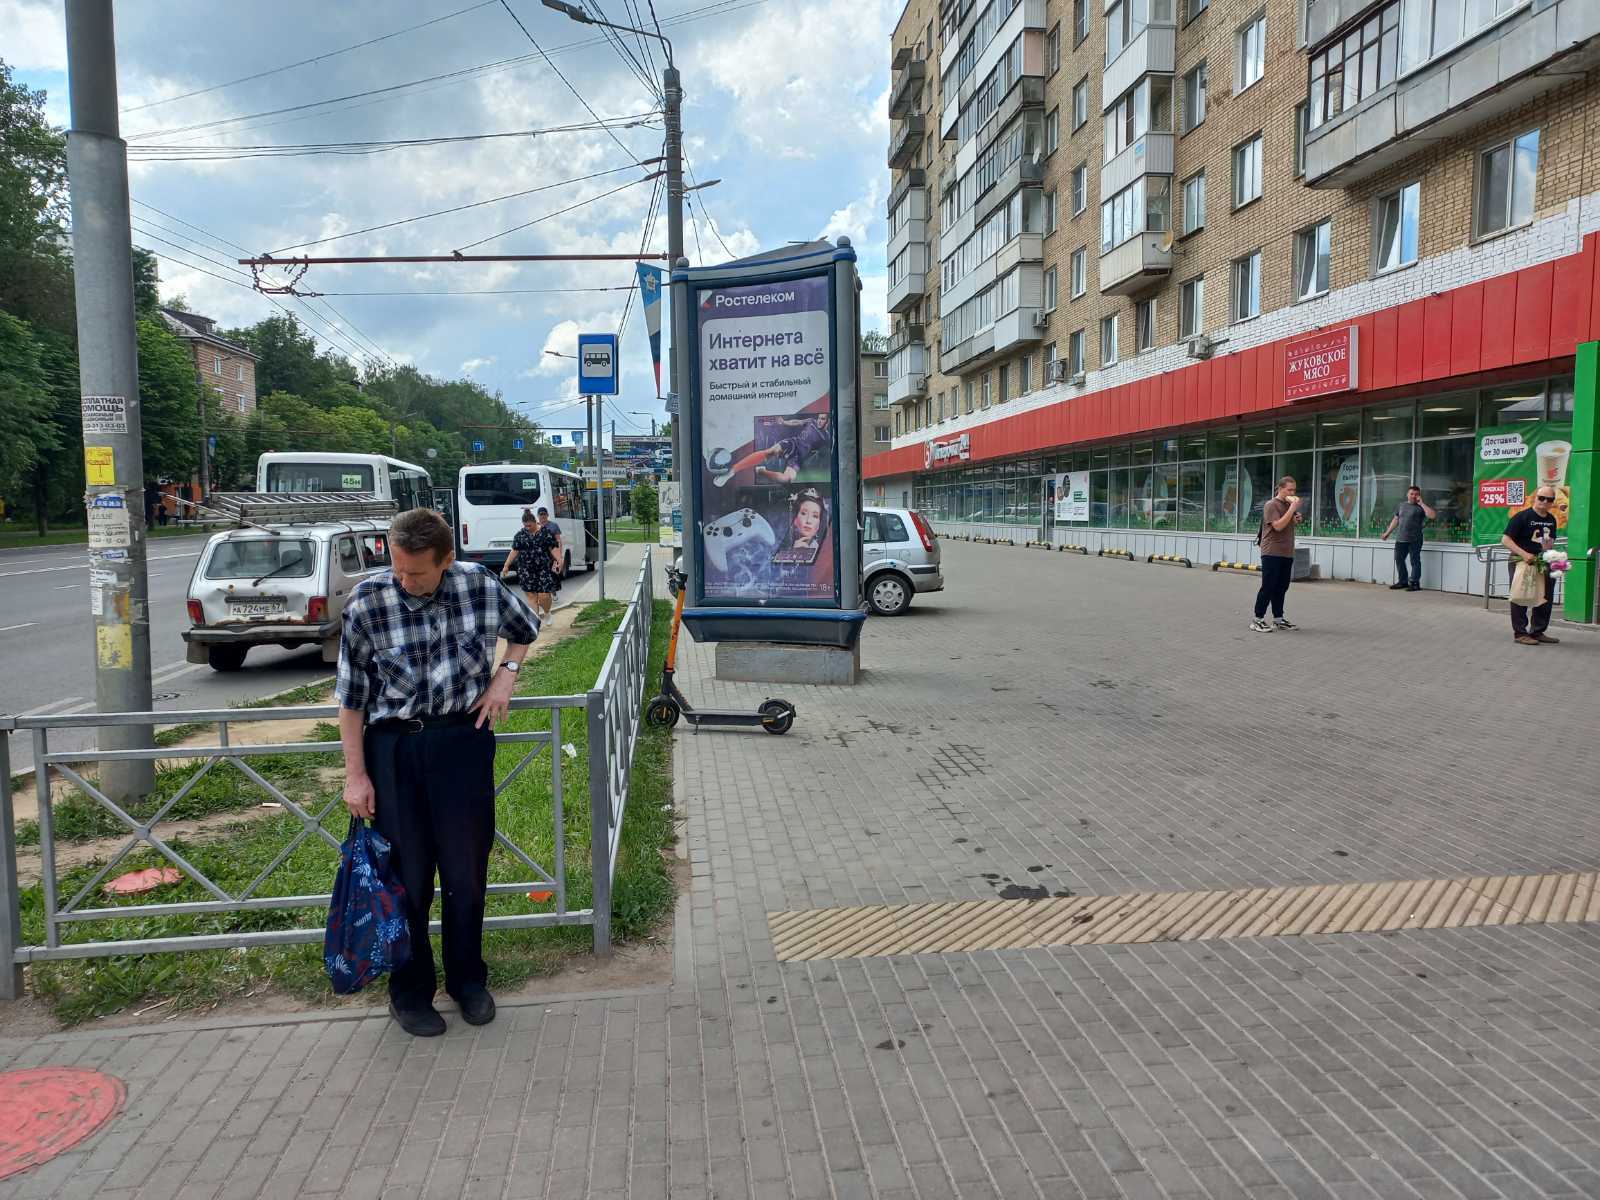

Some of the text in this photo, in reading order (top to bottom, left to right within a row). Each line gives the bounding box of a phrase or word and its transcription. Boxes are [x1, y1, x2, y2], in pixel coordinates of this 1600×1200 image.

[715, 291, 795, 308] Ростелеком
[709, 330, 804, 352] Интернета
[709, 346, 825, 371] хватит на всё
[1289, 347, 1347, 374] ЖУКОВСКОЕ
[1303, 364, 1331, 381] МЯСО
[709, 376, 812, 392] Быстрый и стабильный
[82, 397, 124, 405] СПЛАТНАЯ
[709, 389, 798, 402] домашний интернет
[82, 404, 124, 413] ОМОЩЬ
[1484, 436, 1518, 447] Доставка
[1483, 446, 1525, 457] от 30 минут
[1480, 493, 1505, 504] -25%
